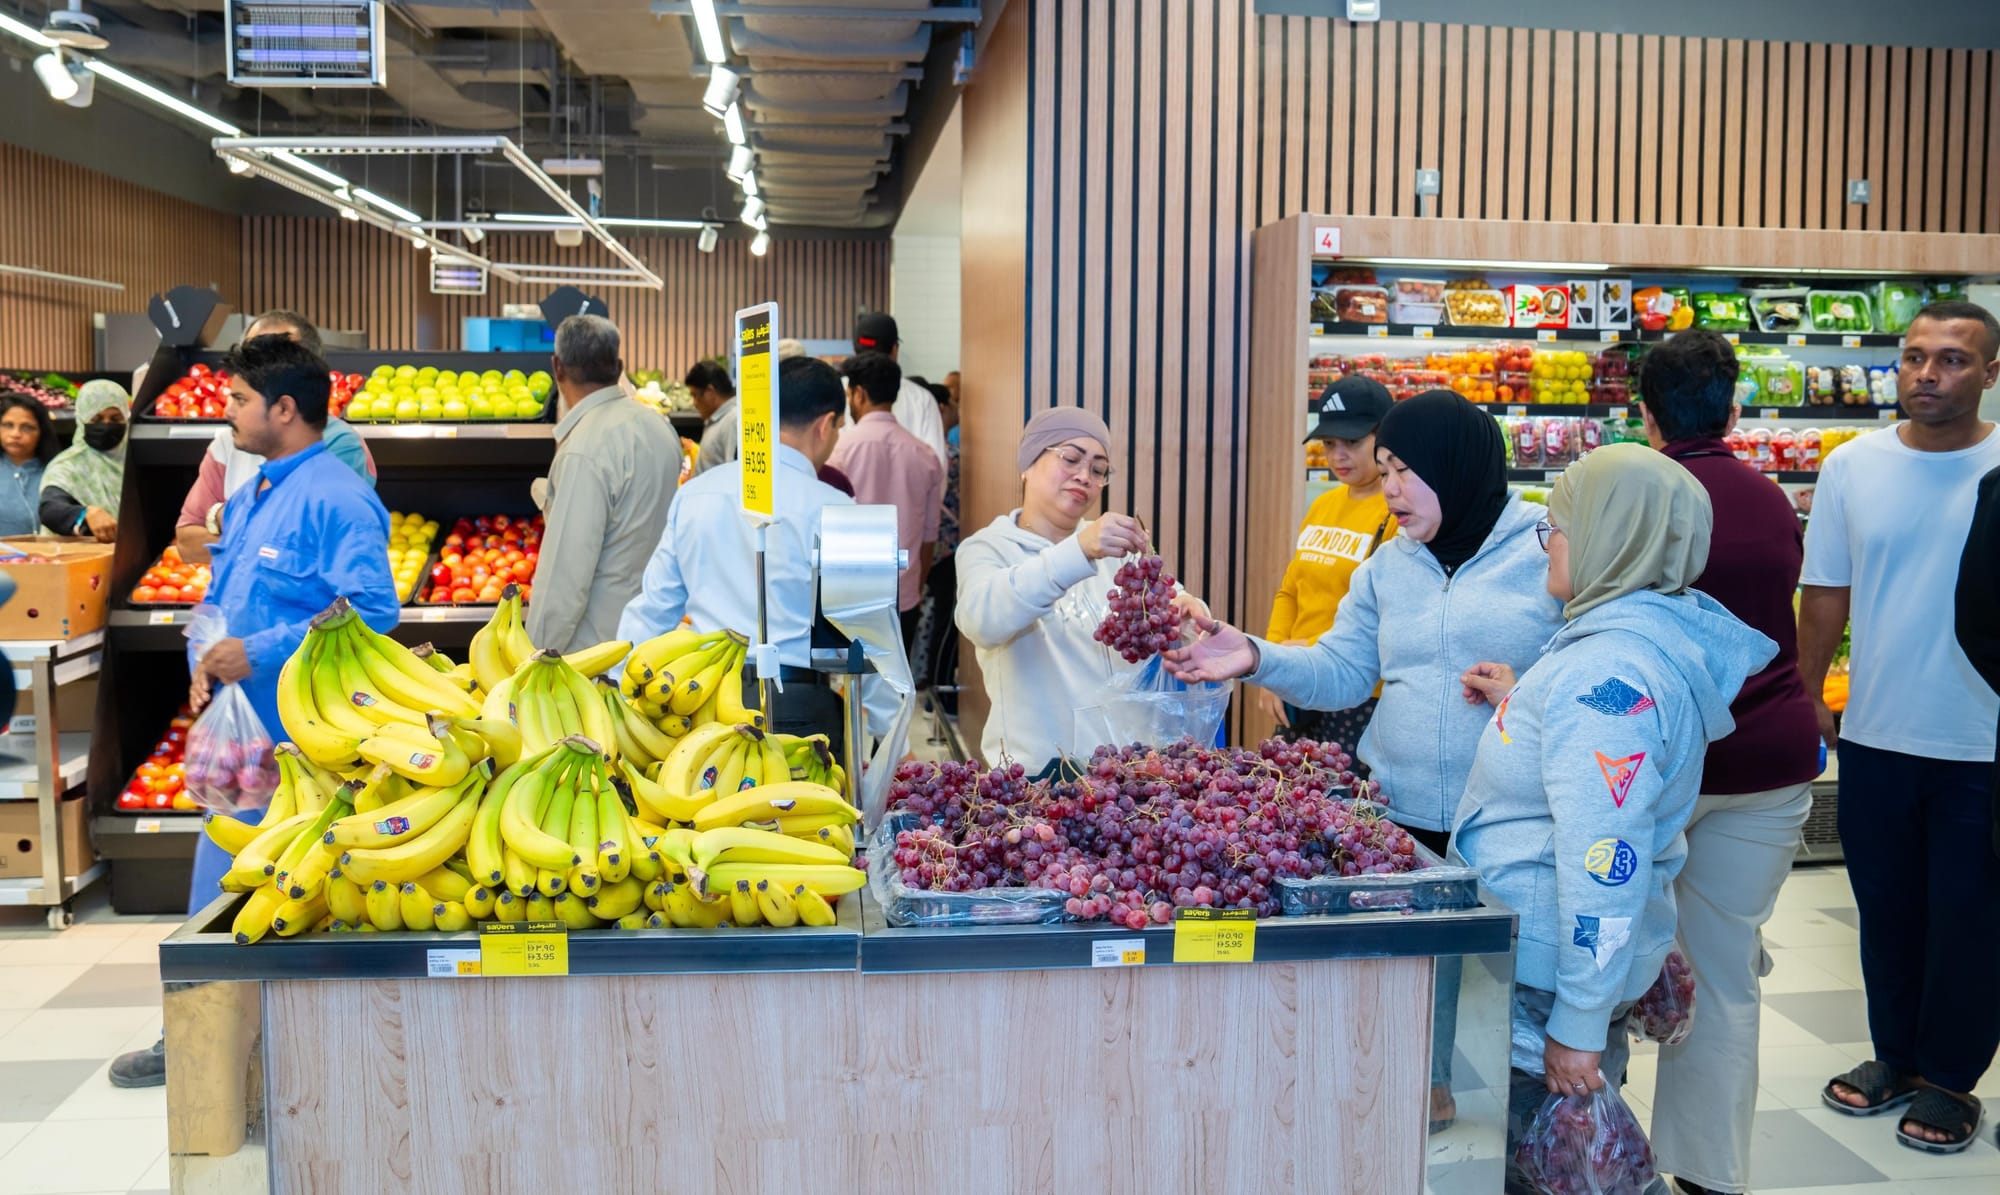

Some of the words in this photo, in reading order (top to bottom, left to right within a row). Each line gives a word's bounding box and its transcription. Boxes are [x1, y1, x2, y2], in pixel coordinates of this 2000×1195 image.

[1322, 232, 1332, 248] 4
[751, 452, 766, 474] 3.95
[1302, 529, 1361, 556] LONDON
[1183, 909, 1211, 917] savers
[486, 923, 515, 931] savers
[535, 952, 556, 961] 3.95
